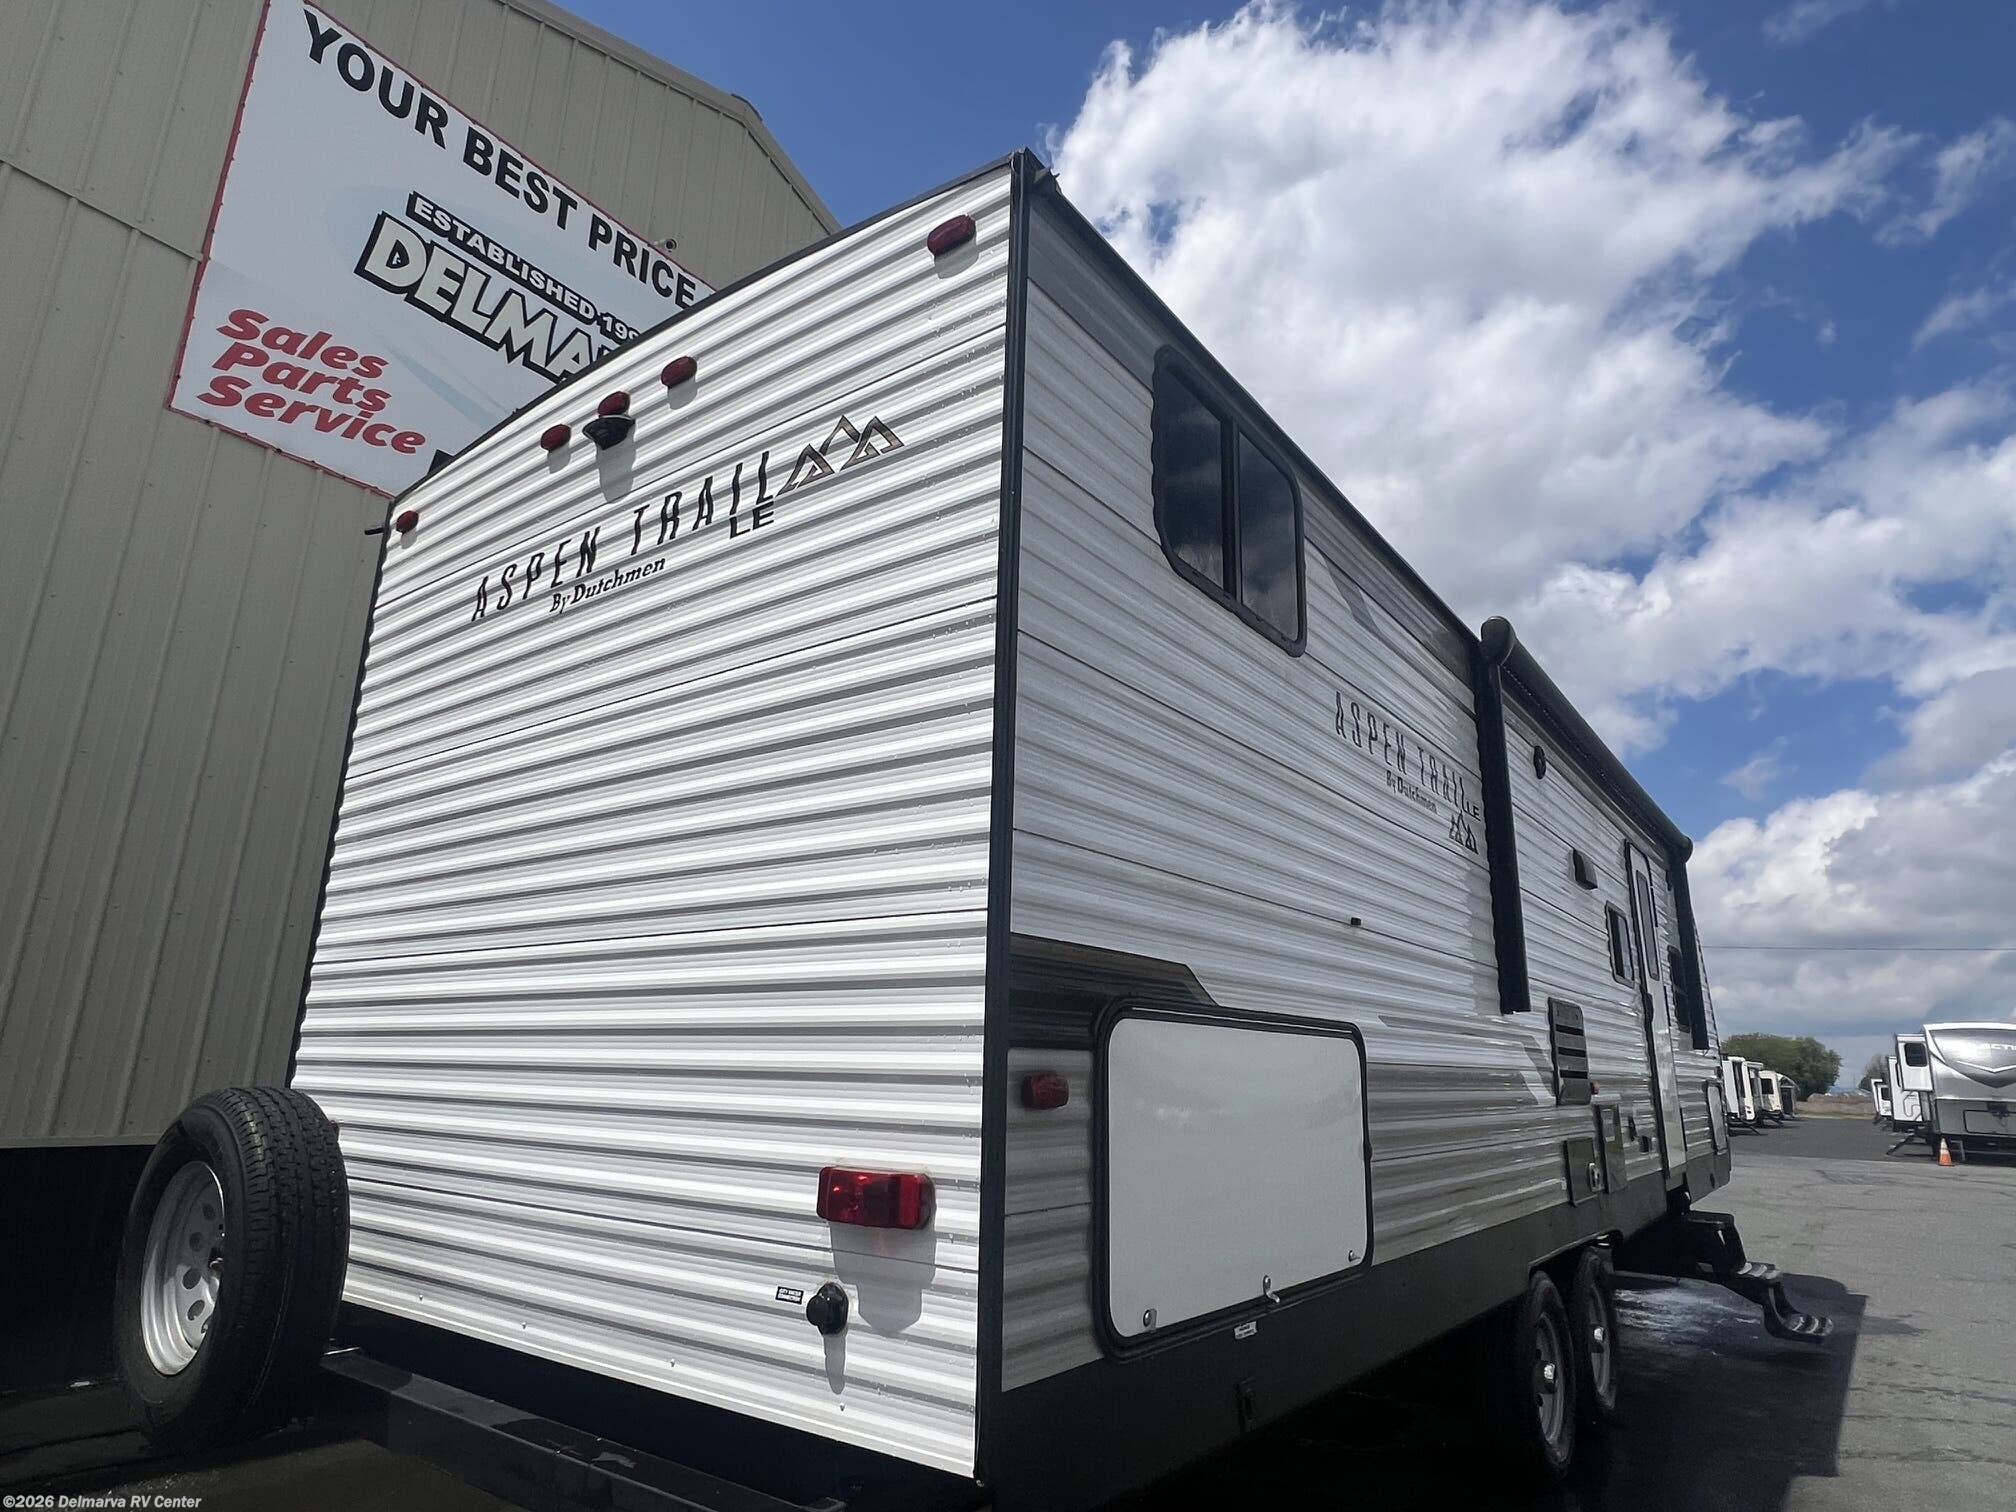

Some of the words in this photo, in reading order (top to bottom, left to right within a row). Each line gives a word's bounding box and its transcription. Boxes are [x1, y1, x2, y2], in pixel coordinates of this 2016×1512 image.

[303, 9, 449, 149] YOUR
[463, 126, 577, 230] BEST
[589, 213, 696, 309] PRICE
[357, 213, 612, 379] DELMA
[411, 195, 597, 322] ESTABLISHED
[212, 344, 391, 413] Parts
[217, 308, 391, 378] Sales
[196, 375, 426, 455] Service
[471, 526, 602, 622] ASPEN
[630, 450, 775, 555] TRAIL
[729, 501, 775, 539] LE
[549, 593, 571, 614] By
[570, 558, 666, 605] Dutchmen
[1335, 691, 1407, 775] ASPEN
[1416, 746, 1468, 813] TRAIL
